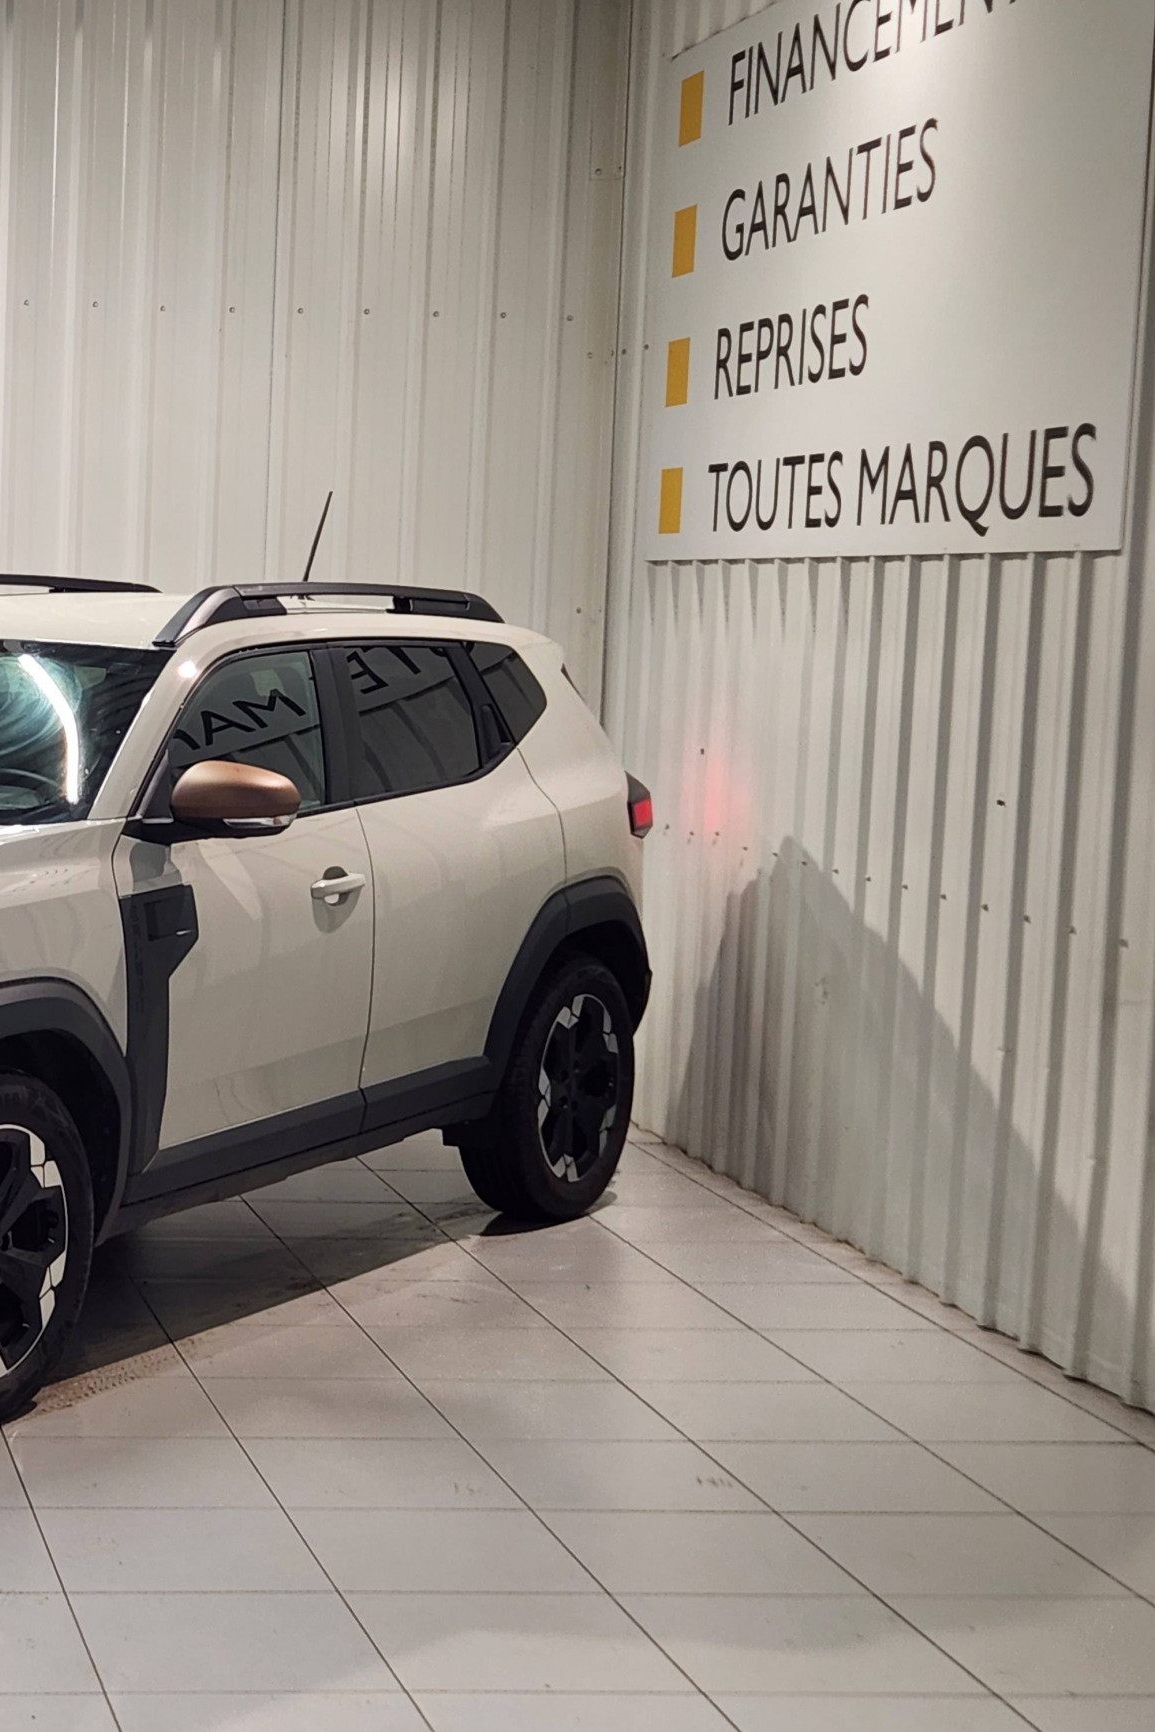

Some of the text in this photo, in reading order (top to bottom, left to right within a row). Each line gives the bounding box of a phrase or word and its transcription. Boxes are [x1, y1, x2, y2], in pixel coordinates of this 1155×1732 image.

[728, 0, 1016, 126] FINANCEM
[721, 117, 938, 262] GARANTIES
[714, 293, 869, 400] REPRISES
[708, 422, 1097, 538] TOUTES MARQUES
